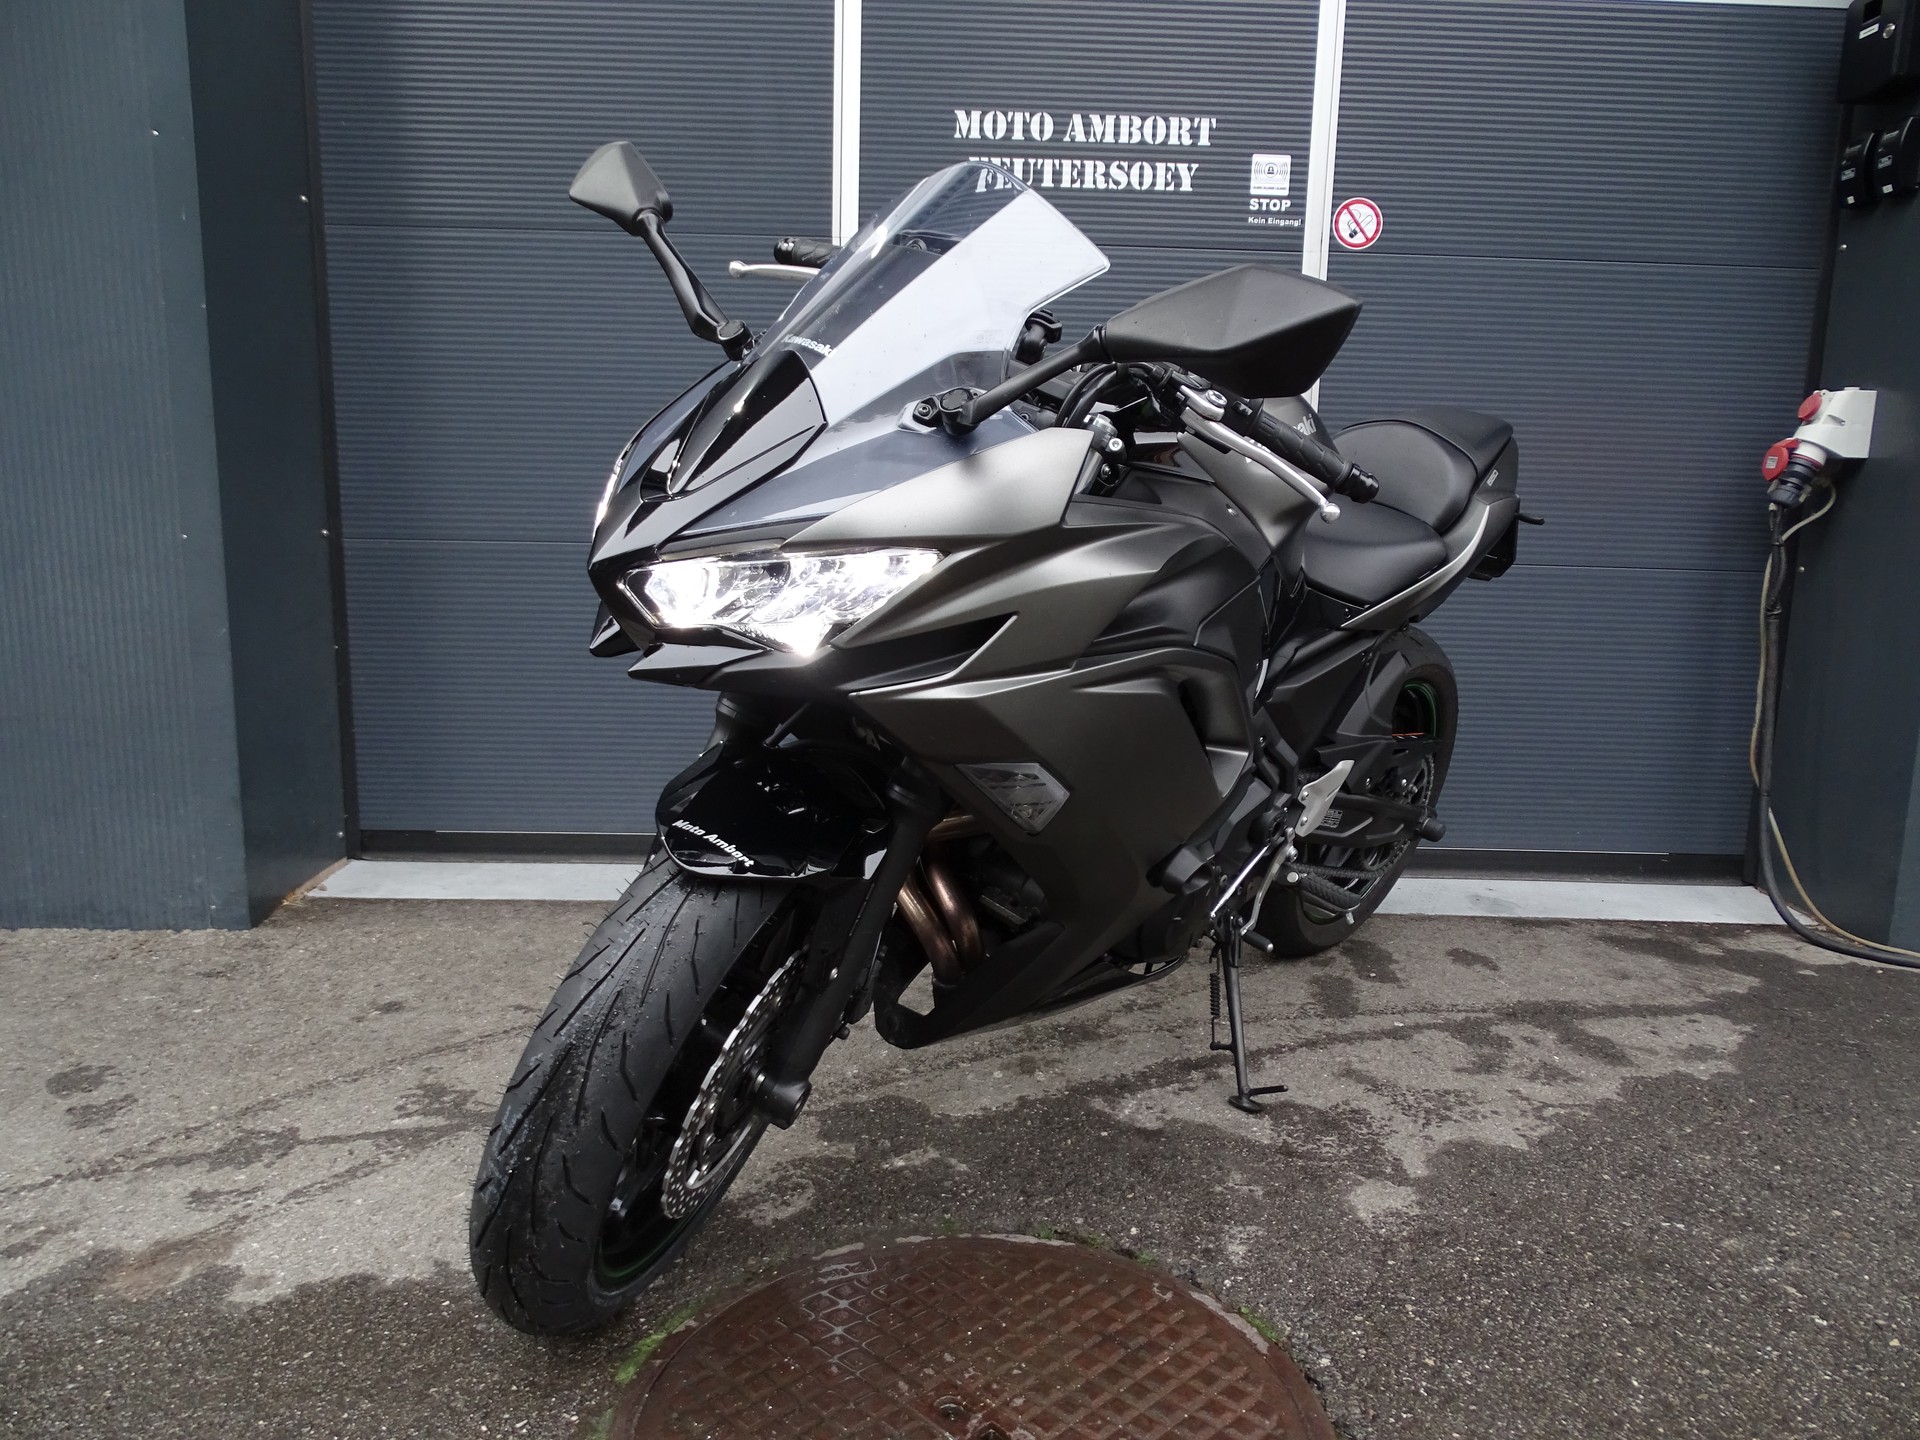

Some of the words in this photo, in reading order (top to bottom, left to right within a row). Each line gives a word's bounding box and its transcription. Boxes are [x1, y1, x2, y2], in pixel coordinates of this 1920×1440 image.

[954, 110, 1054, 142] MOTO
[1063, 113, 1217, 146] AMBORT
[968, 157, 1199, 193] FEUTERSOEY
[1248, 216, 1266, 224] Kein
[1267, 217, 1302, 227] Eingang!
[1249, 198, 1292, 212] STOP
[672, 820, 706, 836] Moto
[703, 834, 755, 867] Ambort
